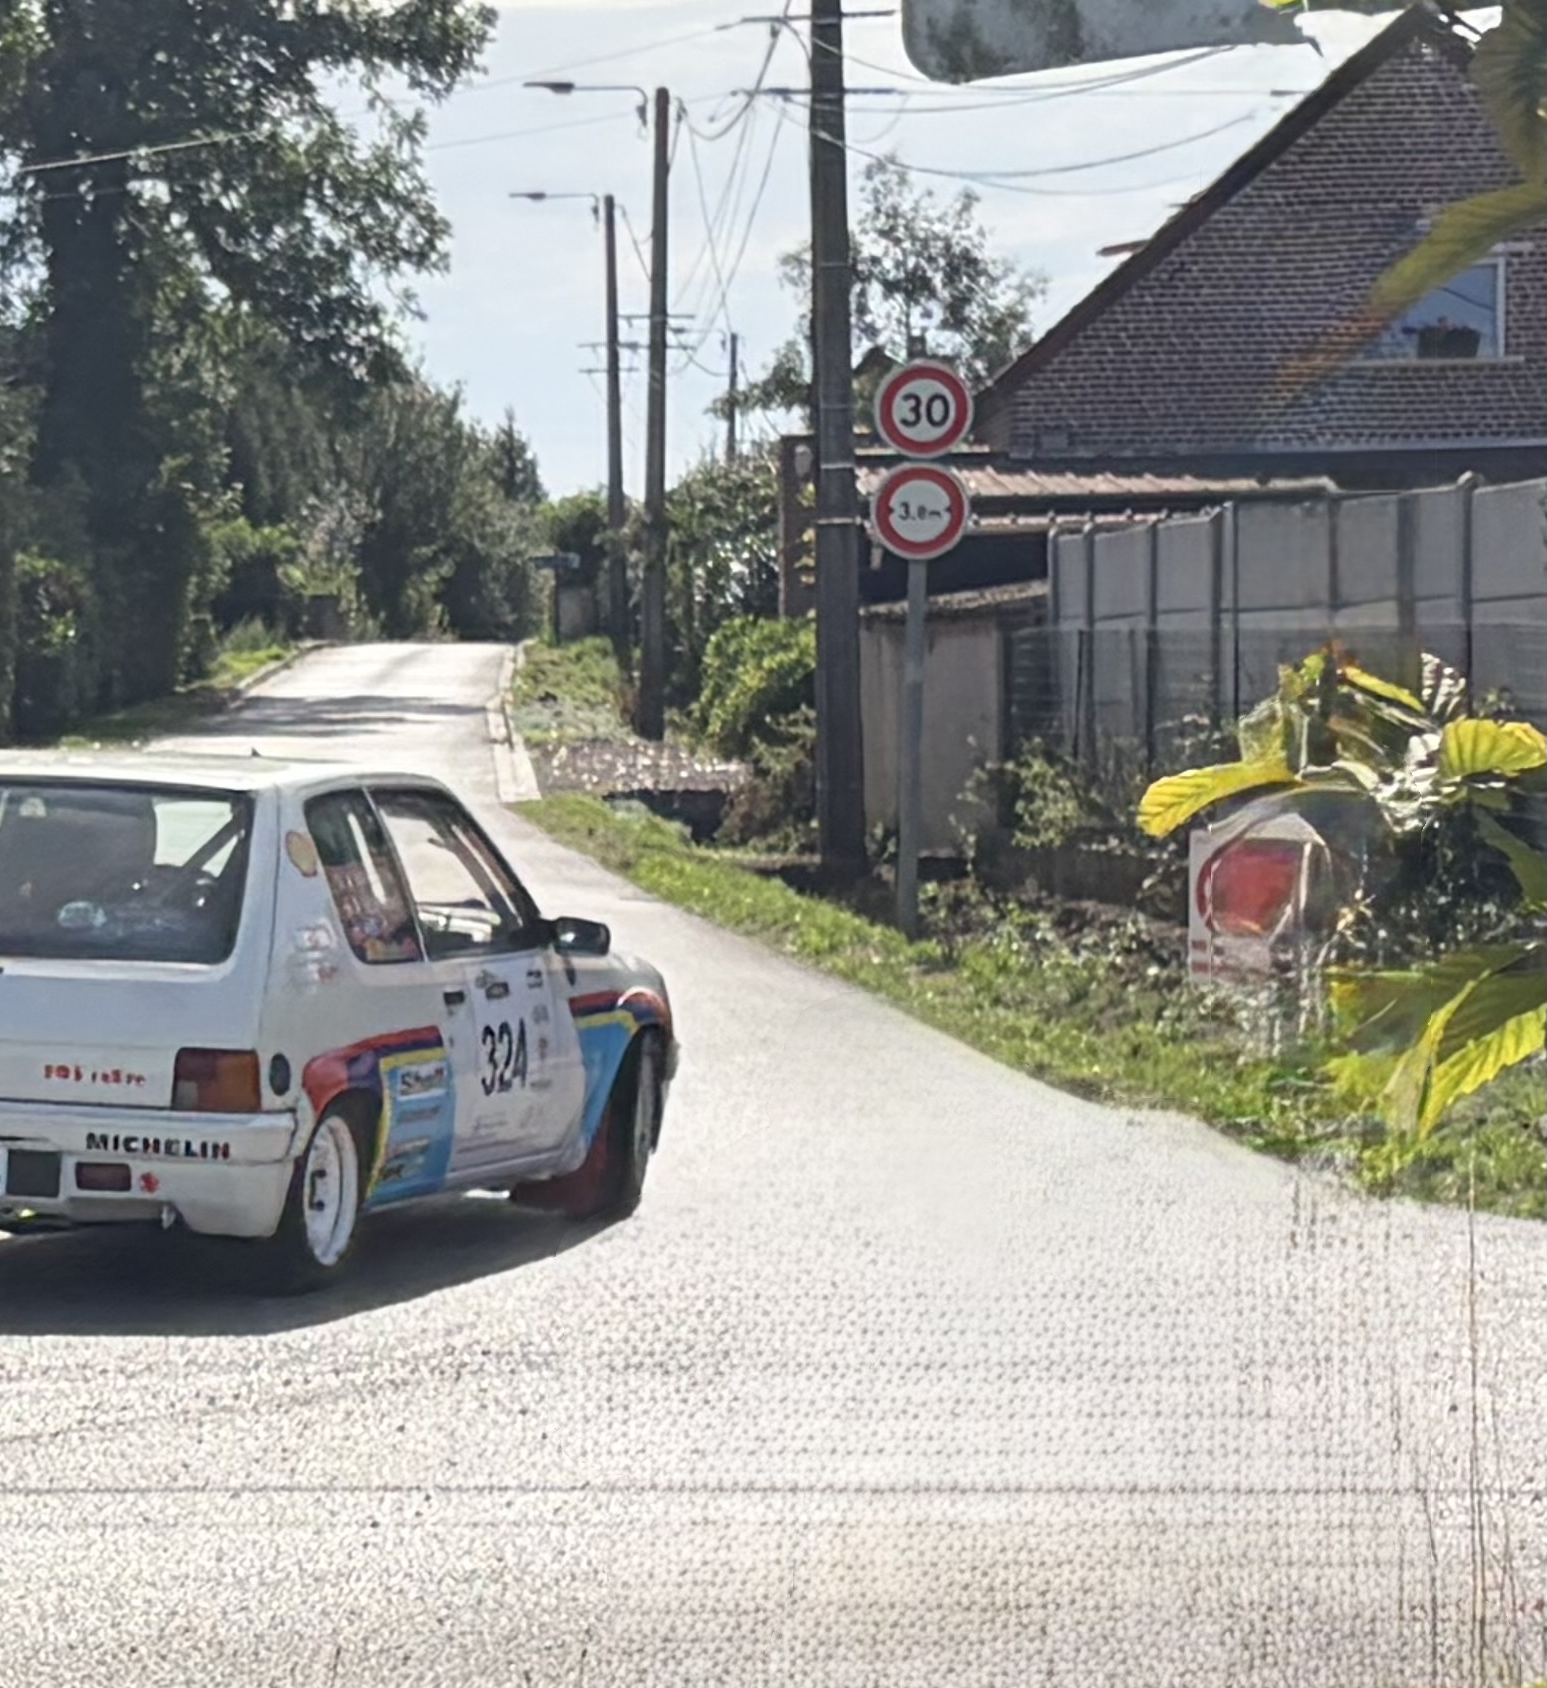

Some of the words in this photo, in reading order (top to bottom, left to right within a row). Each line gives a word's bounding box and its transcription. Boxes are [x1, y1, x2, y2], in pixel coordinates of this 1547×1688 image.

[900, 393, 950, 428] 30
[481, 1017, 529, 1097] 324
[86, 1131, 231, 1160] MICHELIN
